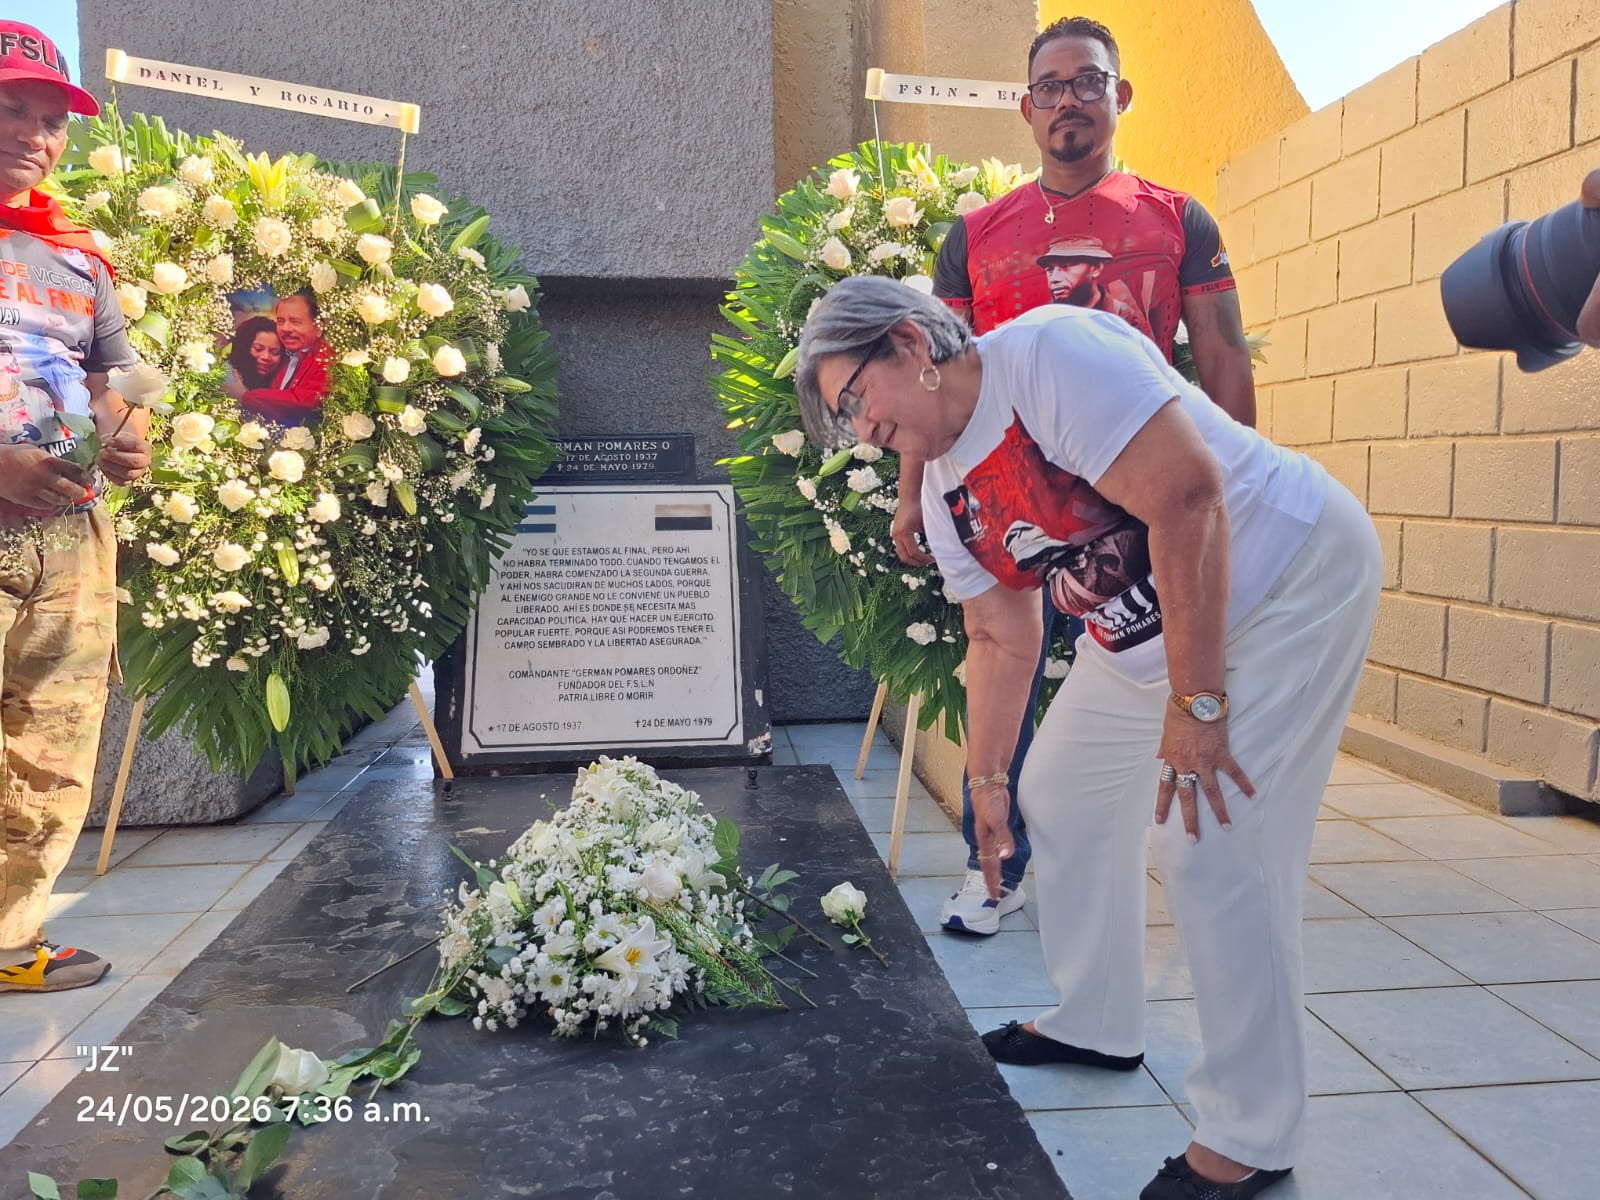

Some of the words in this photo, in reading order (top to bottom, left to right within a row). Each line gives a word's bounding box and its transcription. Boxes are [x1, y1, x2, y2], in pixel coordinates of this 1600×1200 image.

[139, 66, 224, 92] DANIEL
[250, 86, 262, 97] Y
[899, 84, 958, 98] FSLN
[31, 264, 96, 297] VICTOR
[17, 281, 44, 306] AL
[555, 442, 592, 452] RMAN
[597, 441, 658, 451] POMARES
[662, 441, 670, 450] O
[594, 454, 632, 462] AGOSTO
[600, 463, 628, 471] MAYO
[539, 548, 550, 556] SE
[552, 548, 570, 556] QUE
[572, 547, 610, 556] ESTAMOS
[612, 546, 622, 554] AL
[652, 546, 674, 554] PERO
[549, 559, 598, 567] TERMINADO
[626, 558, 662, 566] CUANDO
[664, 557, 708, 566] TENGAMOS
[711, 556, 720, 564] EL
[566, 570, 618, 578] COMENZADO
[632, 568, 672, 577] SEGUNDA
[544, 582, 592, 590] SACUDIRAN
[594, 581, 606, 589] DE
[608, 580, 644, 588] MUCHOS
[678, 579, 712, 588] PORQUE
[501, 594, 512, 602] AL
[514, 594, 554, 602] ENEMIGO
[556, 594, 591, 602] GRANDE
[620, 592, 662, 600] CONVIENE
[664, 591, 676, 599] UN
[678, 590, 710, 598] PUEBLO
[580, 604, 590, 612] ES
[592, 604, 622, 612] DONDE
[624, 603, 635, 612] SE
[636, 602, 676, 610] NECESITA
[678, 602, 696, 610] MAS
[497, 616, 546, 626] CAPACIDAD
[592, 615, 608, 624] HAY
[610, 615, 628, 624] QUE
[630, 614, 658, 622] HACER
[660, 614, 672, 622] UN
[674, 613, 714, 622] EJERCITO
[1126, 611, 1162, 635] POMARES
[495, 629, 536, 638] POPULAR
[574, 627, 611, 636] PORQUE
[612, 626, 626, 634] ASI
[628, 626, 675, 634] PODREMOS
[677, 625, 704, 634] TENER
[706, 624, 716, 632] EL
[504, 641, 536, 650] CAMPO
[538, 640, 586, 648] SEMBRADO
[587, 640, 592, 648] Y
[594, 640, 605, 648] LA
[608, 638, 648, 647] LIBERTAD
[508, 670, 570, 679] COMANDANTE
[614, 666, 656, 676] POMARES
[558, 680, 606, 690] FUNDADOR
[608, 680, 624, 689] DEL
[618, 692, 624, 700] O
[626, 691, 654, 700] MORIR
[496, 724, 506, 732] 17
[508, 723, 520, 732] DE
[522, 722, 560, 732] AGOSTO
[562, 721, 582, 730] 1937
[642, 719, 652, 728] 24
[654, 718, 665, 728] DE
[667, 718, 691, 727] MAYO
[693, 717, 712, 726] 1979
